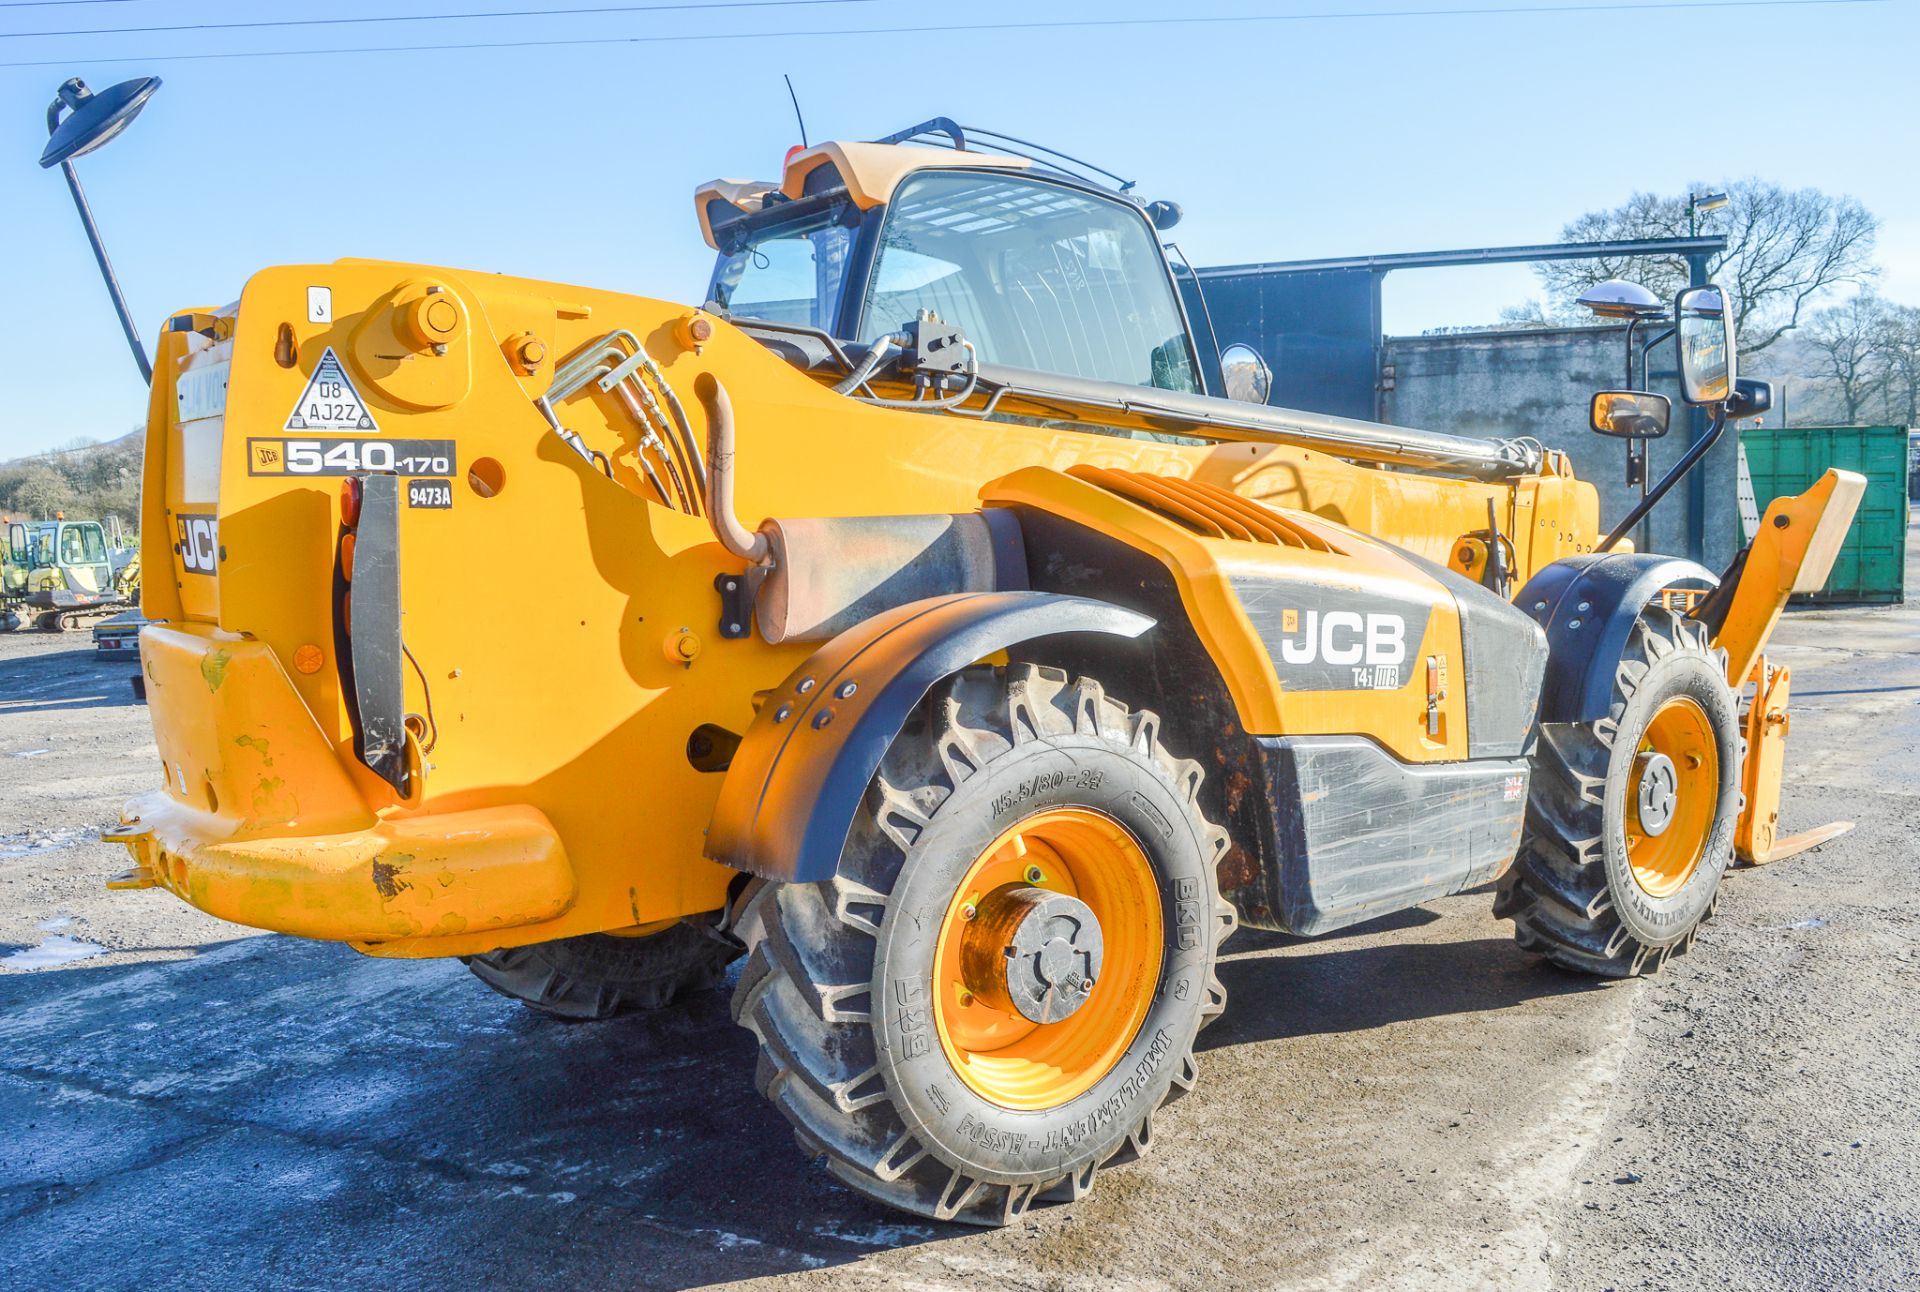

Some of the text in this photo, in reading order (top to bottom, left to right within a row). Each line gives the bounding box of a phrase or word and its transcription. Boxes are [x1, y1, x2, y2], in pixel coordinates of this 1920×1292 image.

[309, 403, 356, 421] AJ2Z
[259, 449, 278, 464] JCB
[409, 487, 451, 505] 9473A
[1282, 610, 1406, 664] JCB
[1352, 667, 1373, 687] T4i
[1174, 877, 1202, 950] BKT
[895, 976, 930, 1061] BKT
